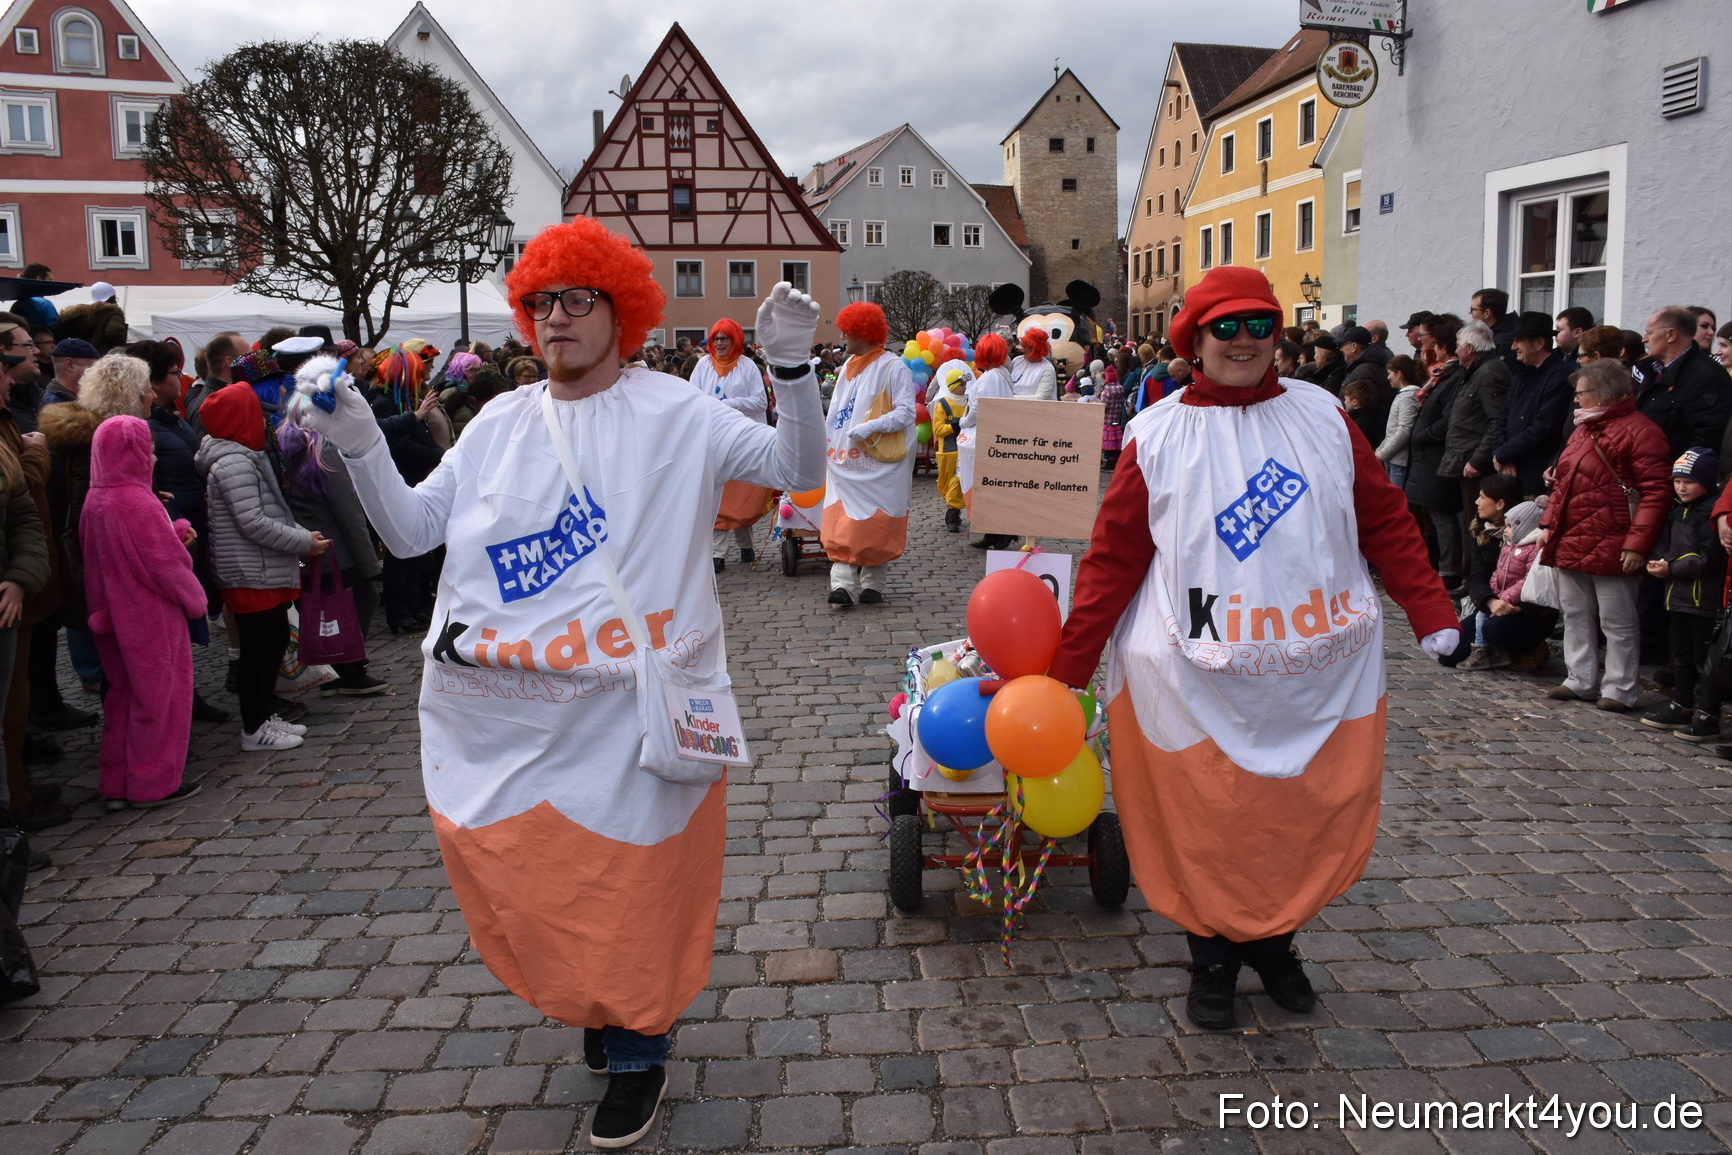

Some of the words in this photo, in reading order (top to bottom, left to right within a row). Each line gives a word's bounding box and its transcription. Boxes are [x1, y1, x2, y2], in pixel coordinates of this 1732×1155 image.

[1331, 5, 1367, 16] Bella
[1305, 12, 1345, 23] Roma
[1333, 91, 1361, 99] BERCHING
[995, 435, 1029, 446] Immer
[1032, 436, 1049, 447] für
[1052, 438, 1073, 449] eine
[988, 447, 1057, 464] Überraschung
[1060, 454, 1079, 465] gut!
[1043, 481, 1088, 492] Pollanten
